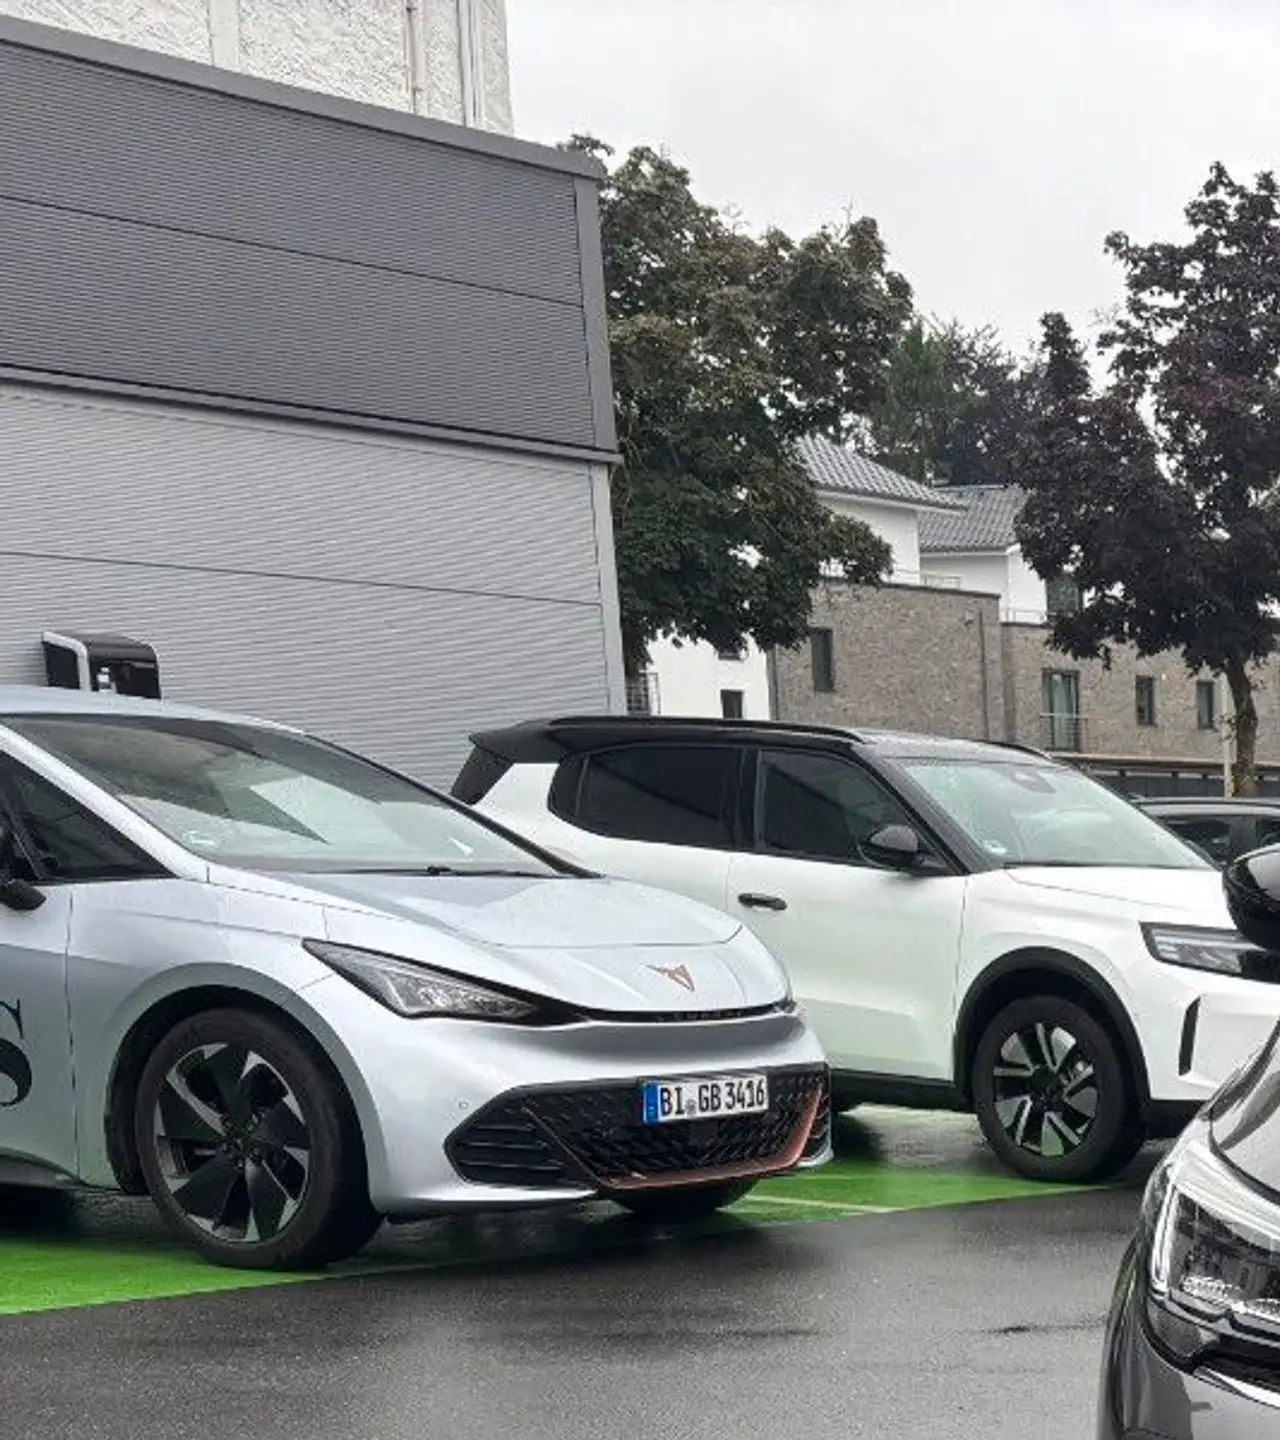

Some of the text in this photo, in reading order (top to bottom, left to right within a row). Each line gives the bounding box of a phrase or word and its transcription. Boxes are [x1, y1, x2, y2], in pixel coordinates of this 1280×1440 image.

[660, 1079, 765, 1116] BI GB 3416
